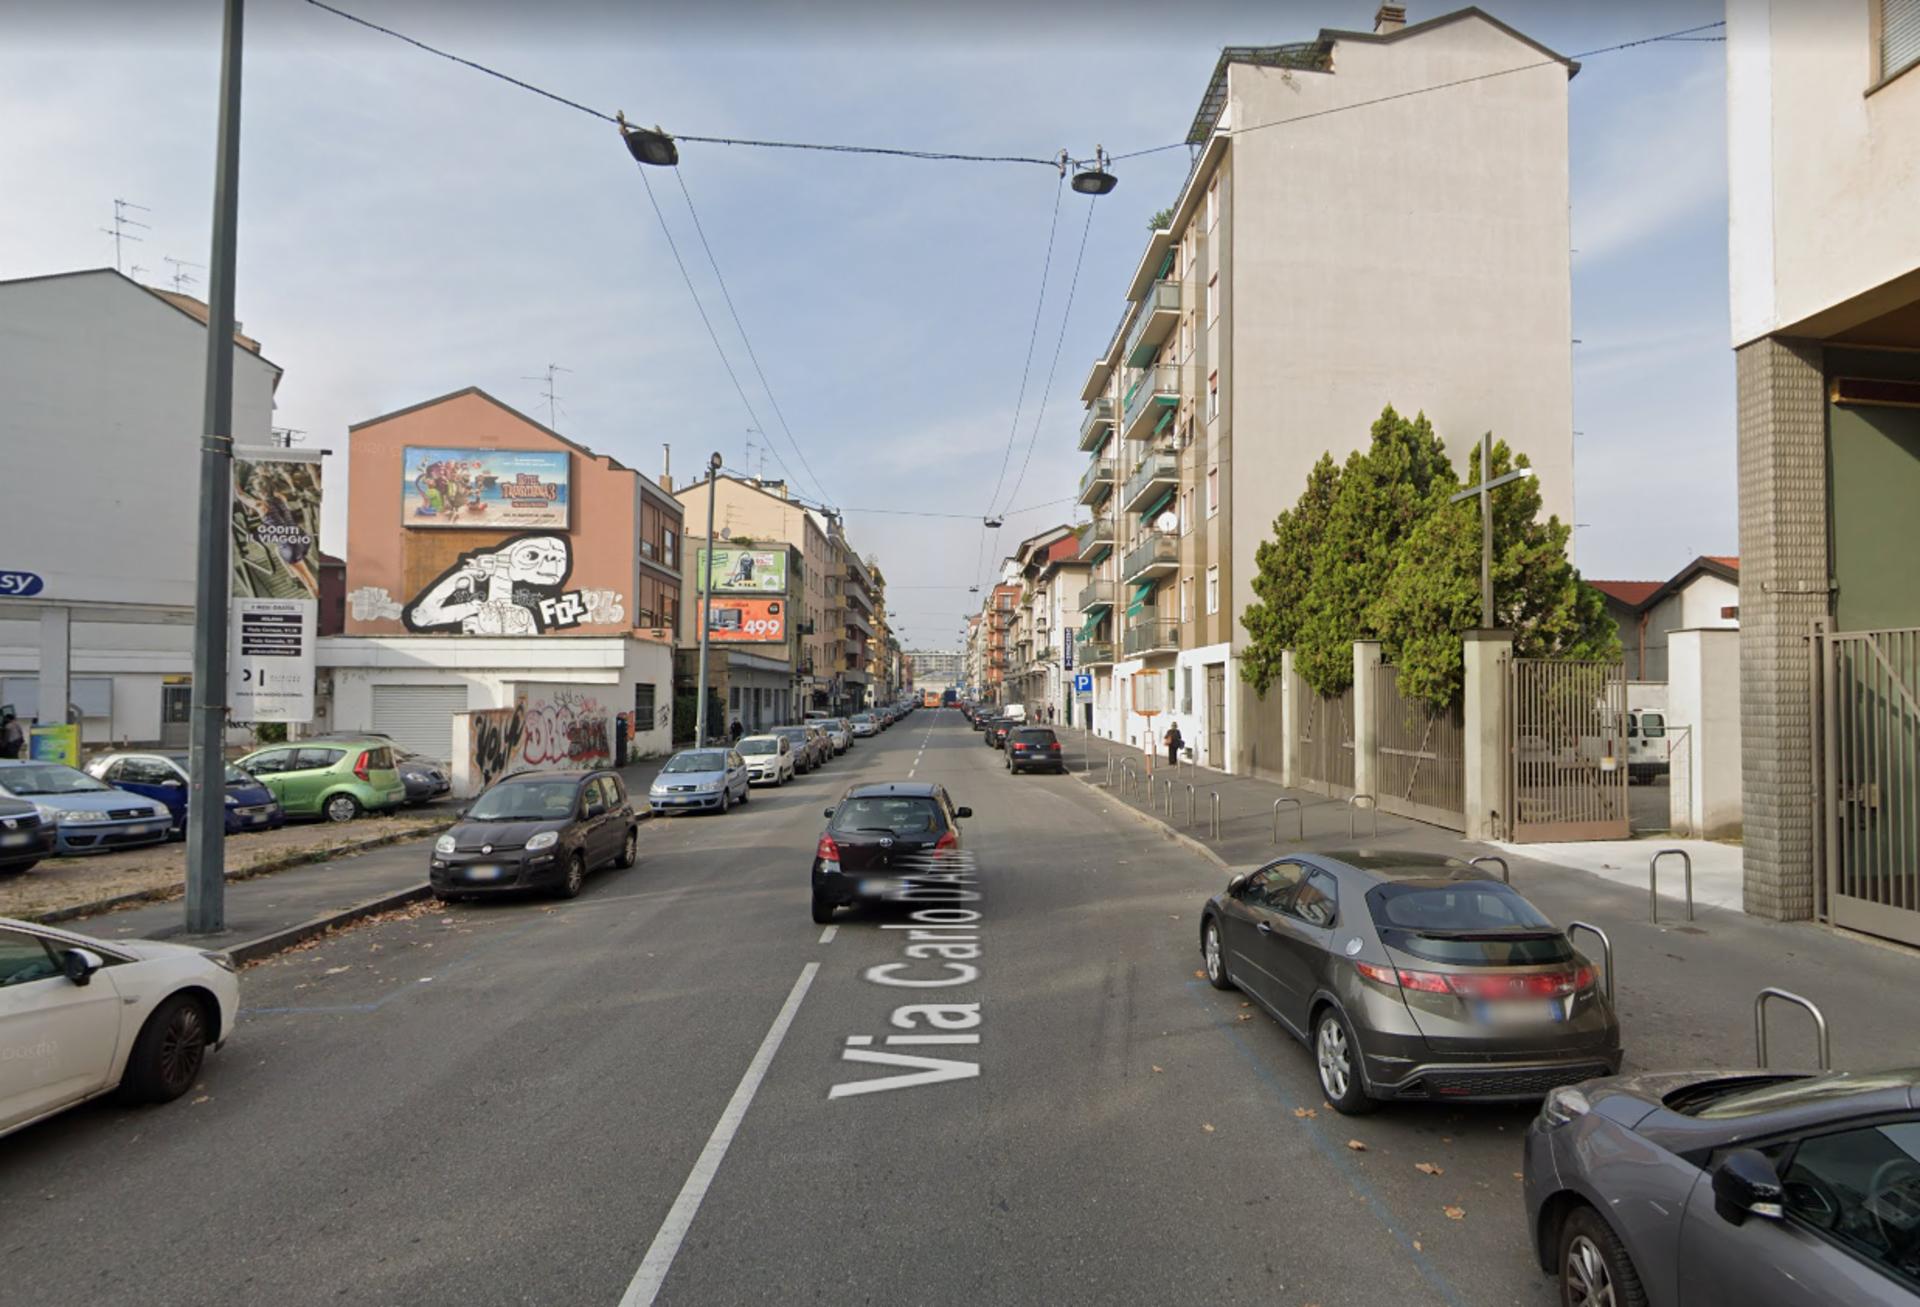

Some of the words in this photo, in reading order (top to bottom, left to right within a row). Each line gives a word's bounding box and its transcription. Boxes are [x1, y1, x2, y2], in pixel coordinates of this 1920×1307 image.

[257, 525, 300, 534] GODITI
[259, 534, 311, 544] VIAGGIO
[743, 619, 780, 635] 499
[1078, 676, 1089, 690] P
